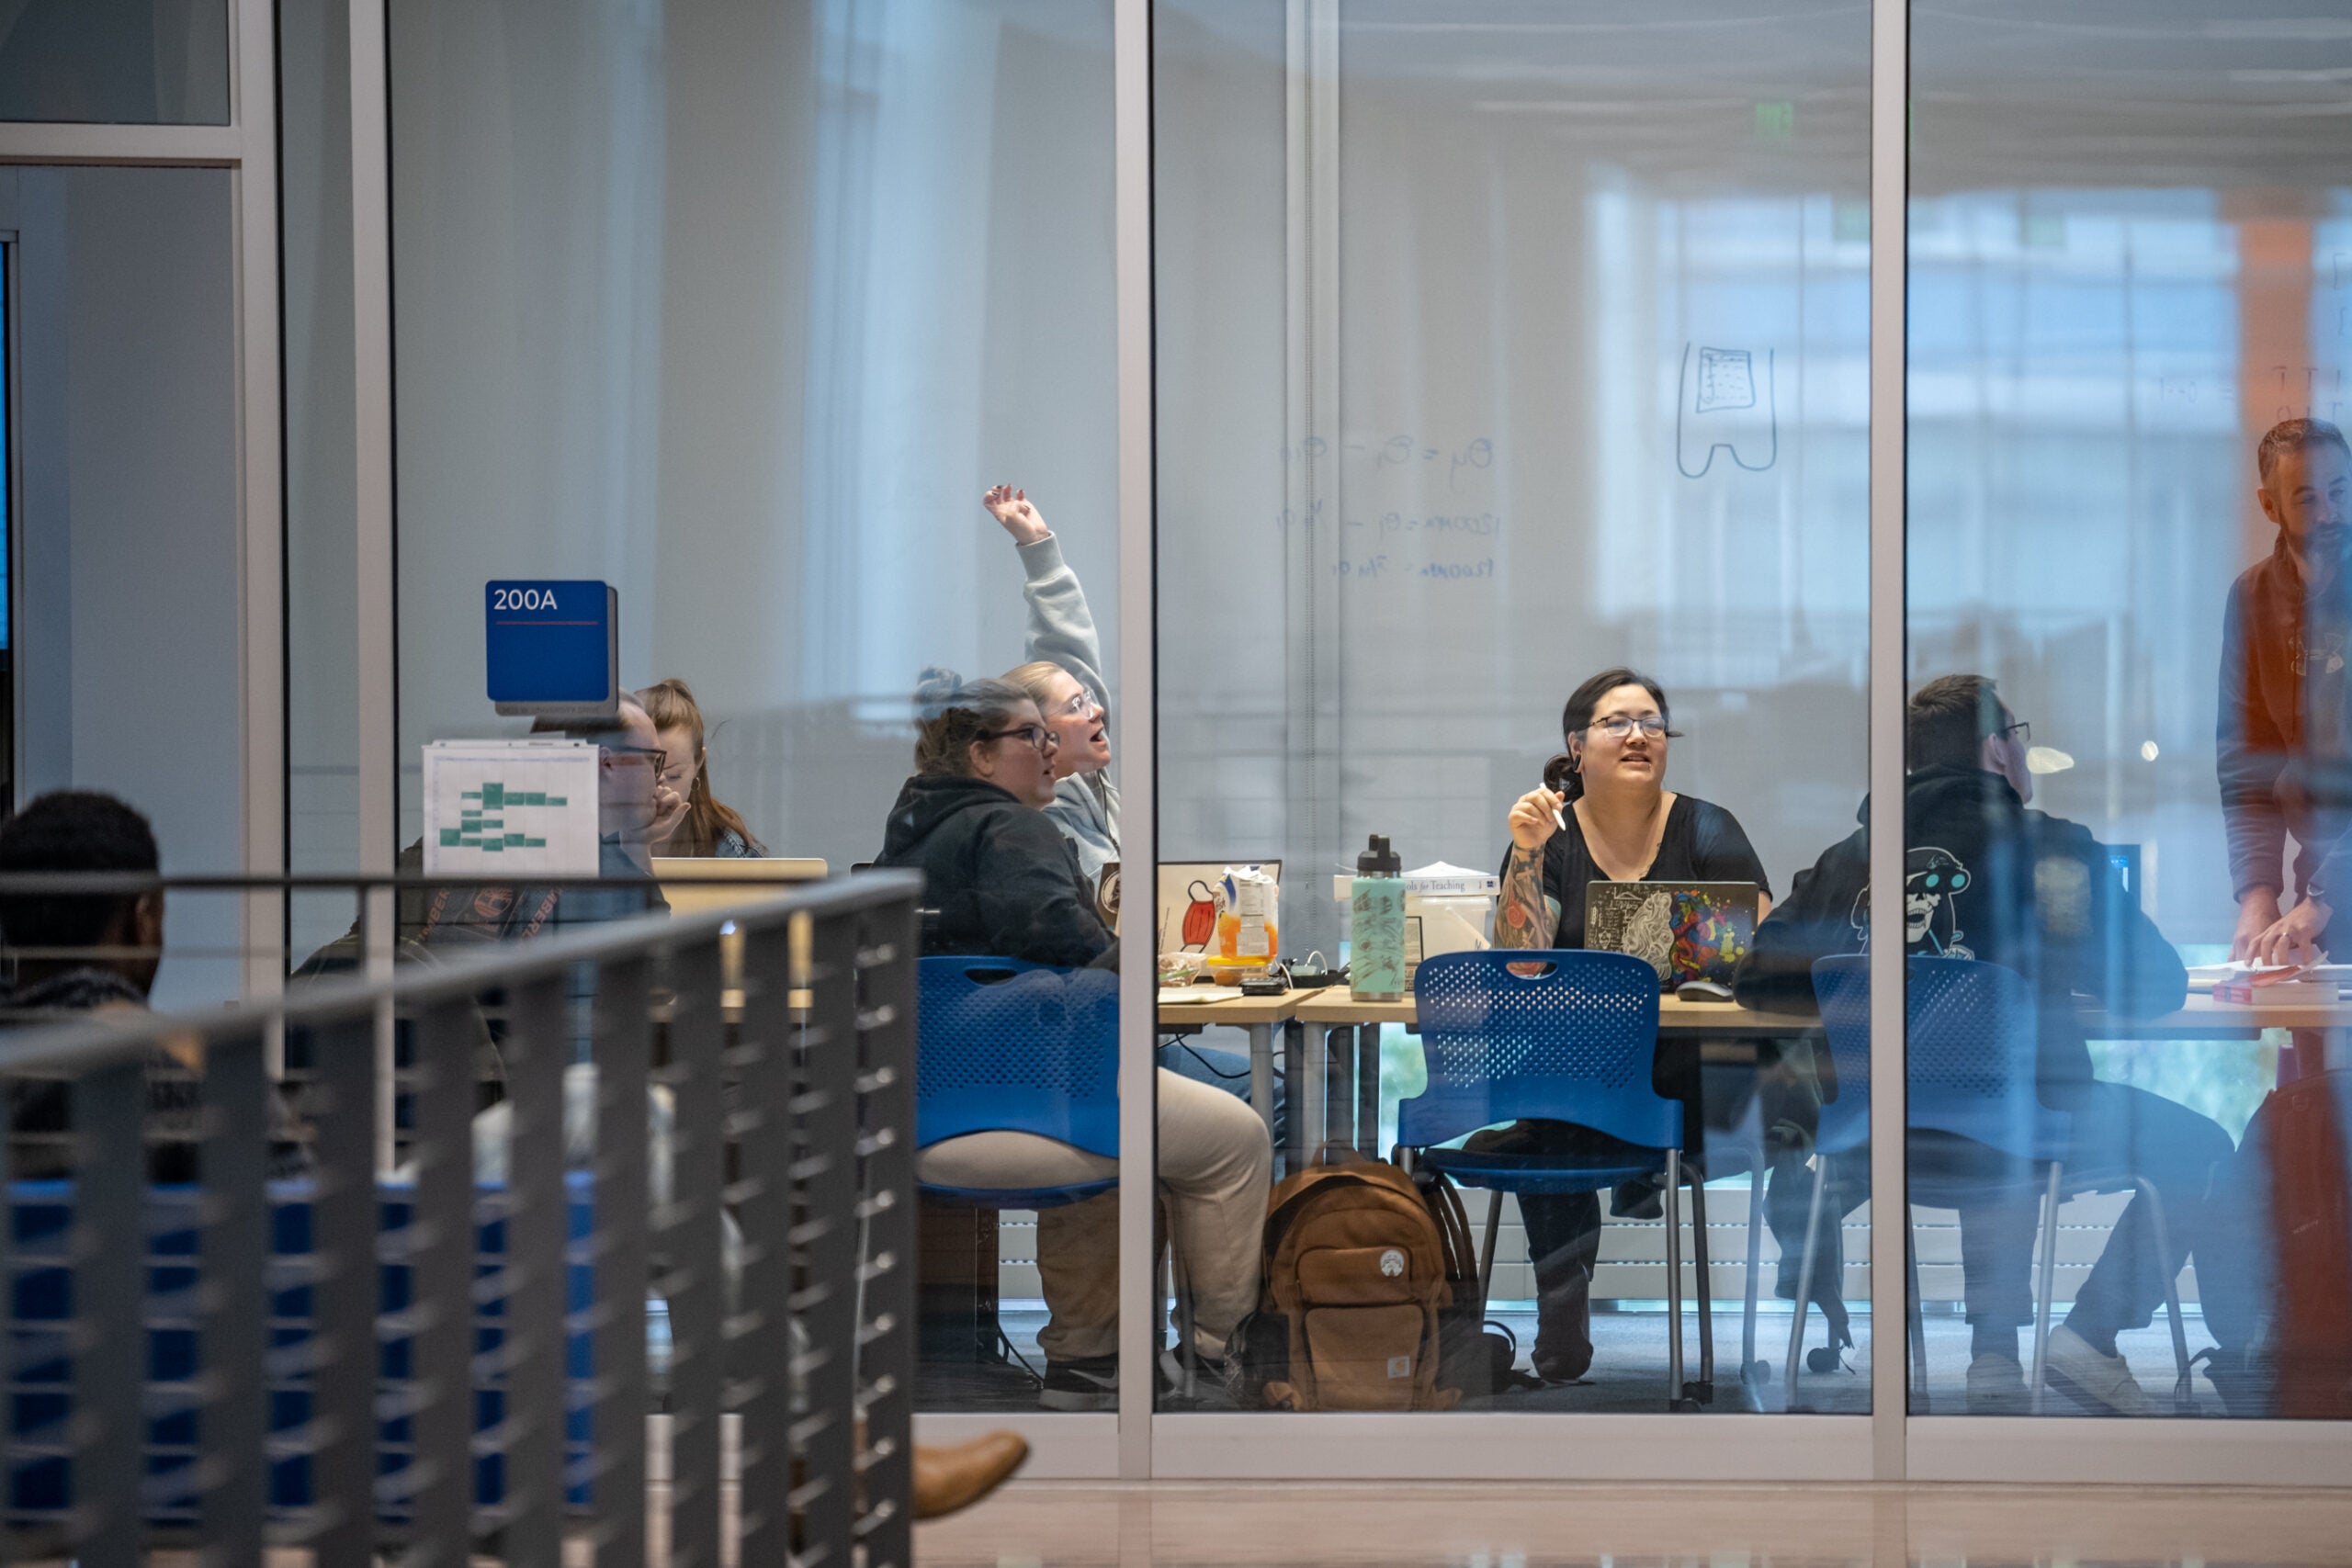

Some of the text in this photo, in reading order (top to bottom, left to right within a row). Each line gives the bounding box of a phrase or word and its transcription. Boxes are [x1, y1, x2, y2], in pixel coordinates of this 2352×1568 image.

[493, 589, 558, 610] 200A
[1406, 881, 1418, 890] ols
[1431, 880, 1466, 892] Teaching
